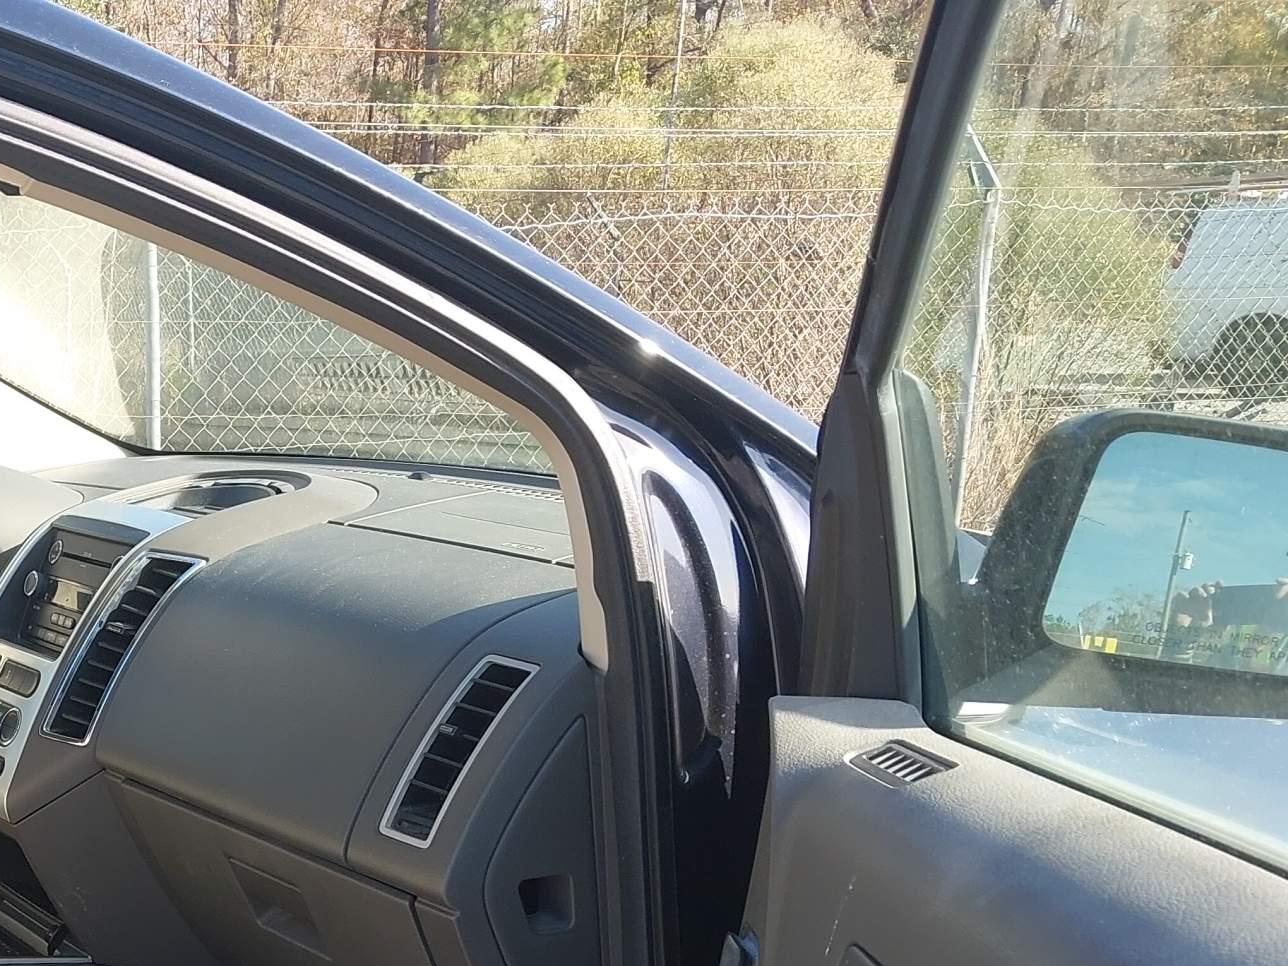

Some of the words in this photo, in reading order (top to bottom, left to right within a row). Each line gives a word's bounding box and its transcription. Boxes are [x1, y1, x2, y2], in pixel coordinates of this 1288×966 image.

[1132, 633, 1183, 649] CLOSER
[1231, 645, 1263, 658] THEY
[1229, 631, 1280, 646] MIRROR
